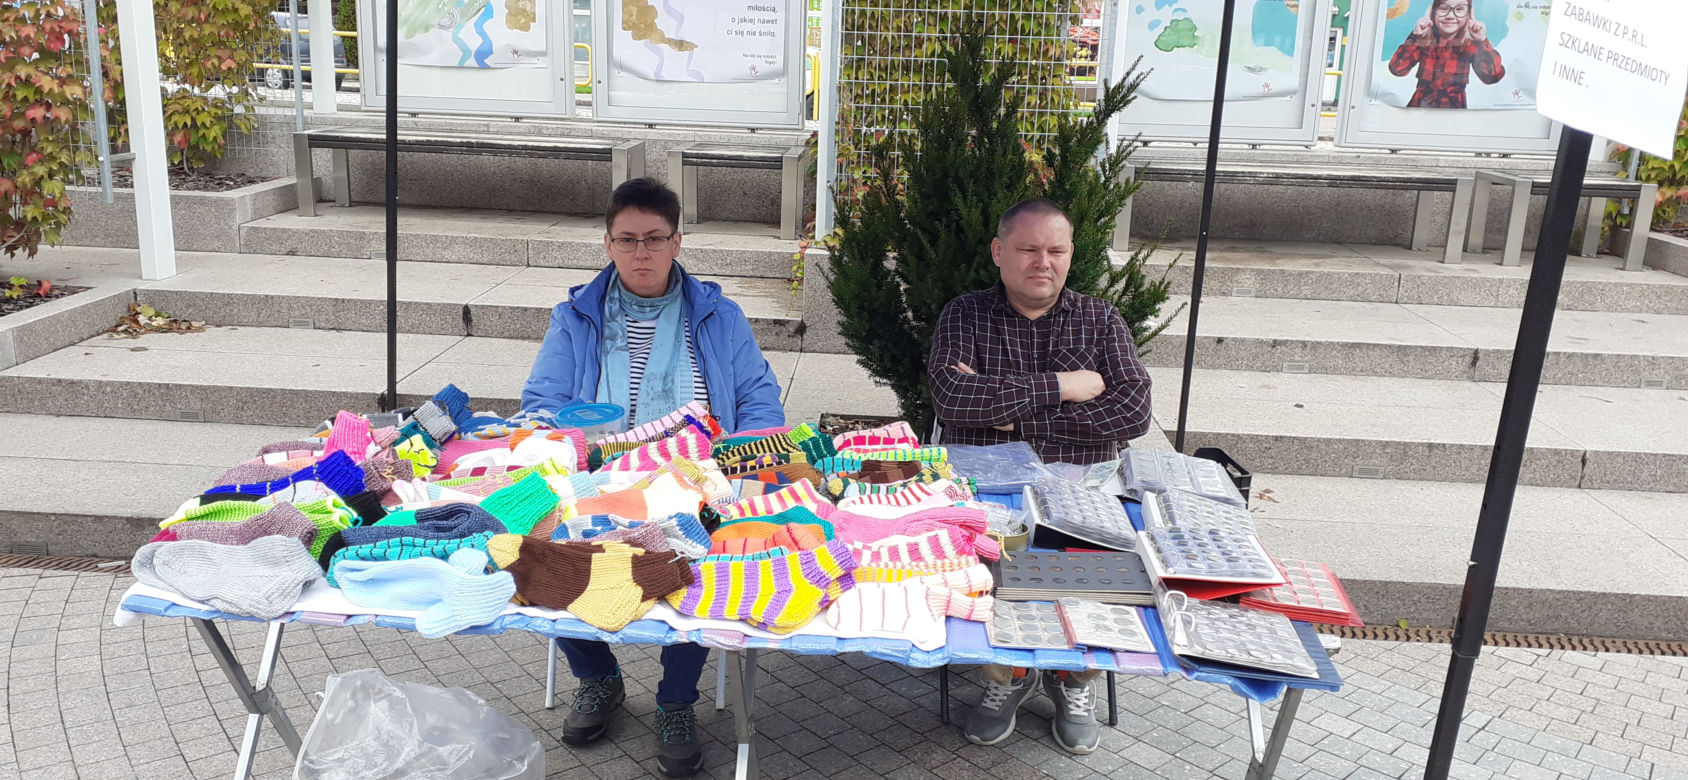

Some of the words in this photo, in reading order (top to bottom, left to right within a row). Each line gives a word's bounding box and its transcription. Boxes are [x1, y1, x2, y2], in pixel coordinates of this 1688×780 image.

[726, 28, 733, 36] ci
[734, 28, 745, 38] się
[746, 29, 757, 37] nie
[737, 16, 756, 26] jakiej
[757, 17, 778, 25] nawet
[1563, 1, 1612, 33] ZABAWKI
[1613, 21, 1620, 37] Z
[1622, 25, 1648, 48] P.R.L.
[1558, 31, 1604, 61] SZKLANE
[1606, 49, 1671, 86] PRZEDMIOTY
[1552, 61, 1558, 76] I
[1558, 63, 1585, 86] INNE
